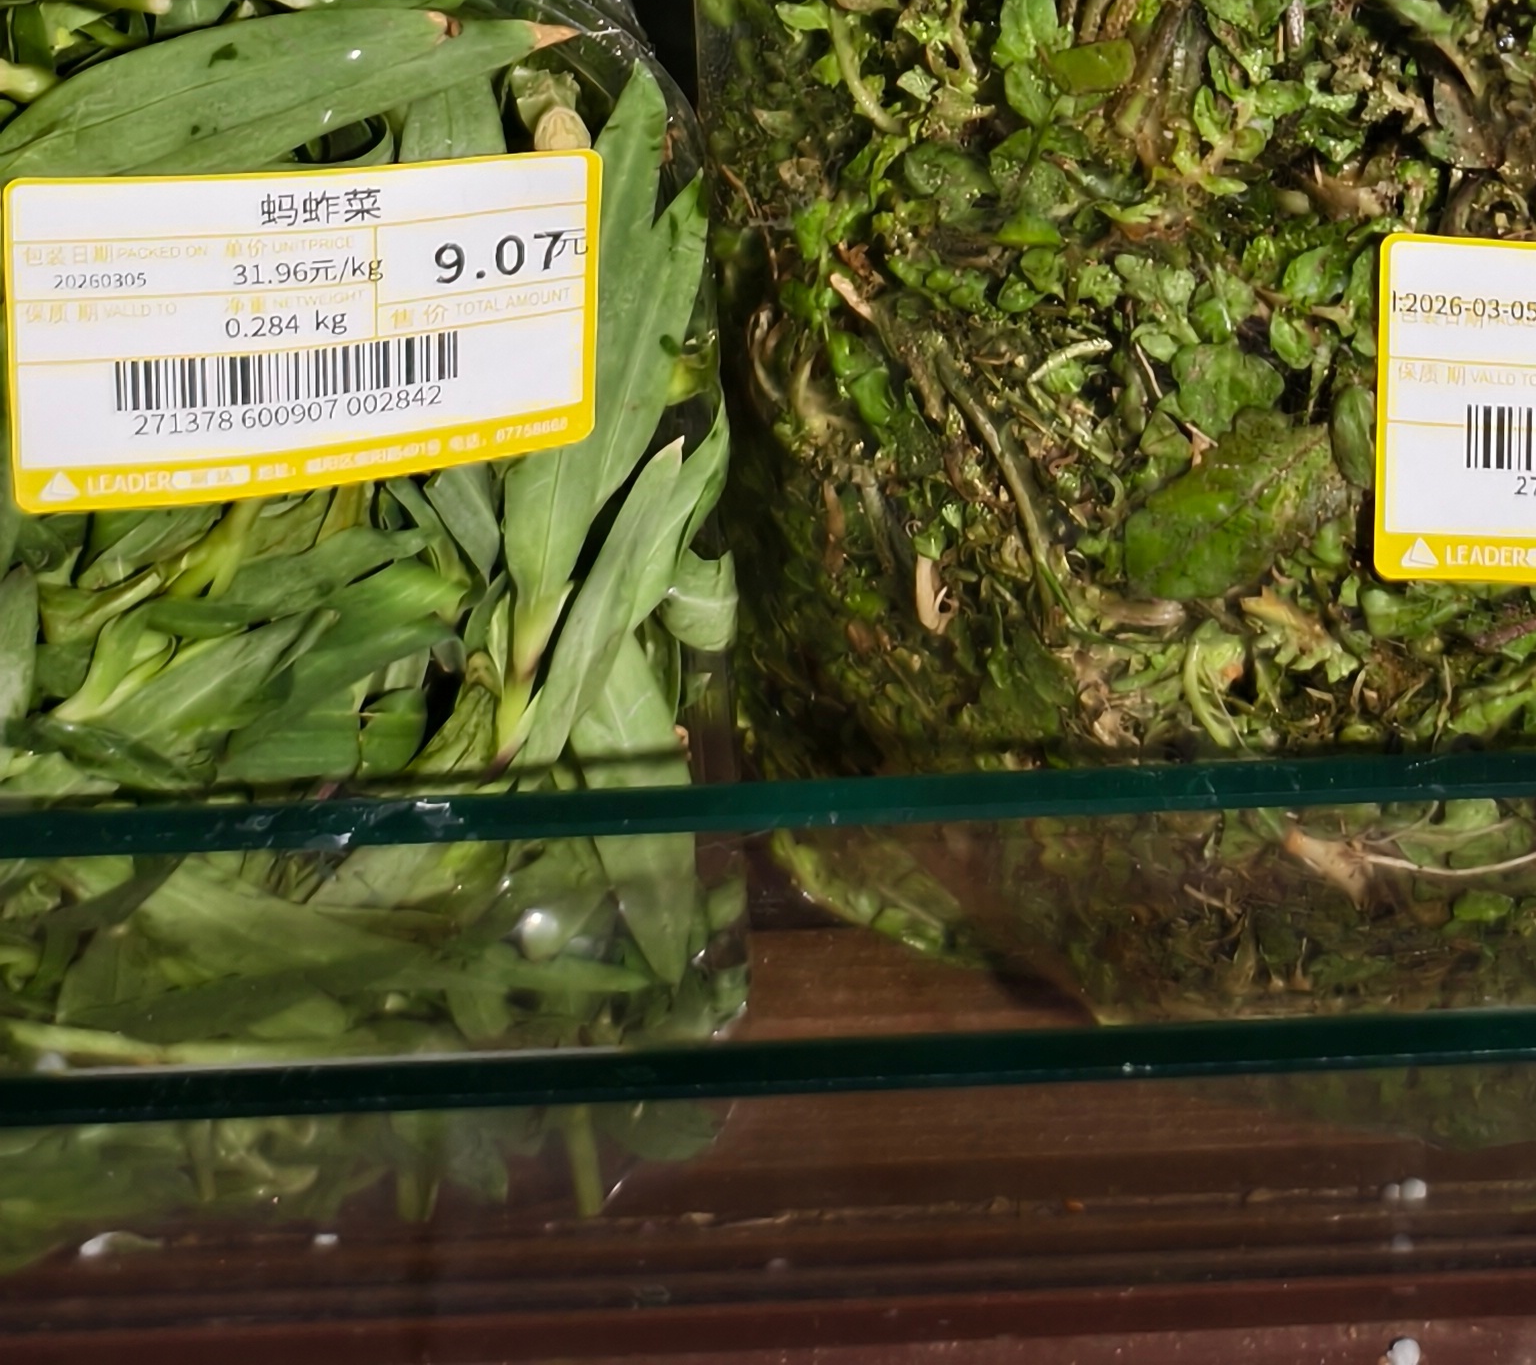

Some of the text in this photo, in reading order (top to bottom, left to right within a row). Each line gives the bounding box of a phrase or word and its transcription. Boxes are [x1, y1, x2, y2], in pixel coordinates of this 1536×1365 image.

[261, 187, 383, 226] 蚂蚱菜
[233, 256, 384, 288] 31.96元/kg
[435, 231, 563, 284] 9.07
[53, 271, 147, 291] 20260305
[225, 309, 348, 340] 0.284 kg
[133, 384, 443, 437] 271378 600907 002842
[87, 472, 172, 496] LEADER
[1445, 545, 1527, 567] LEADER
